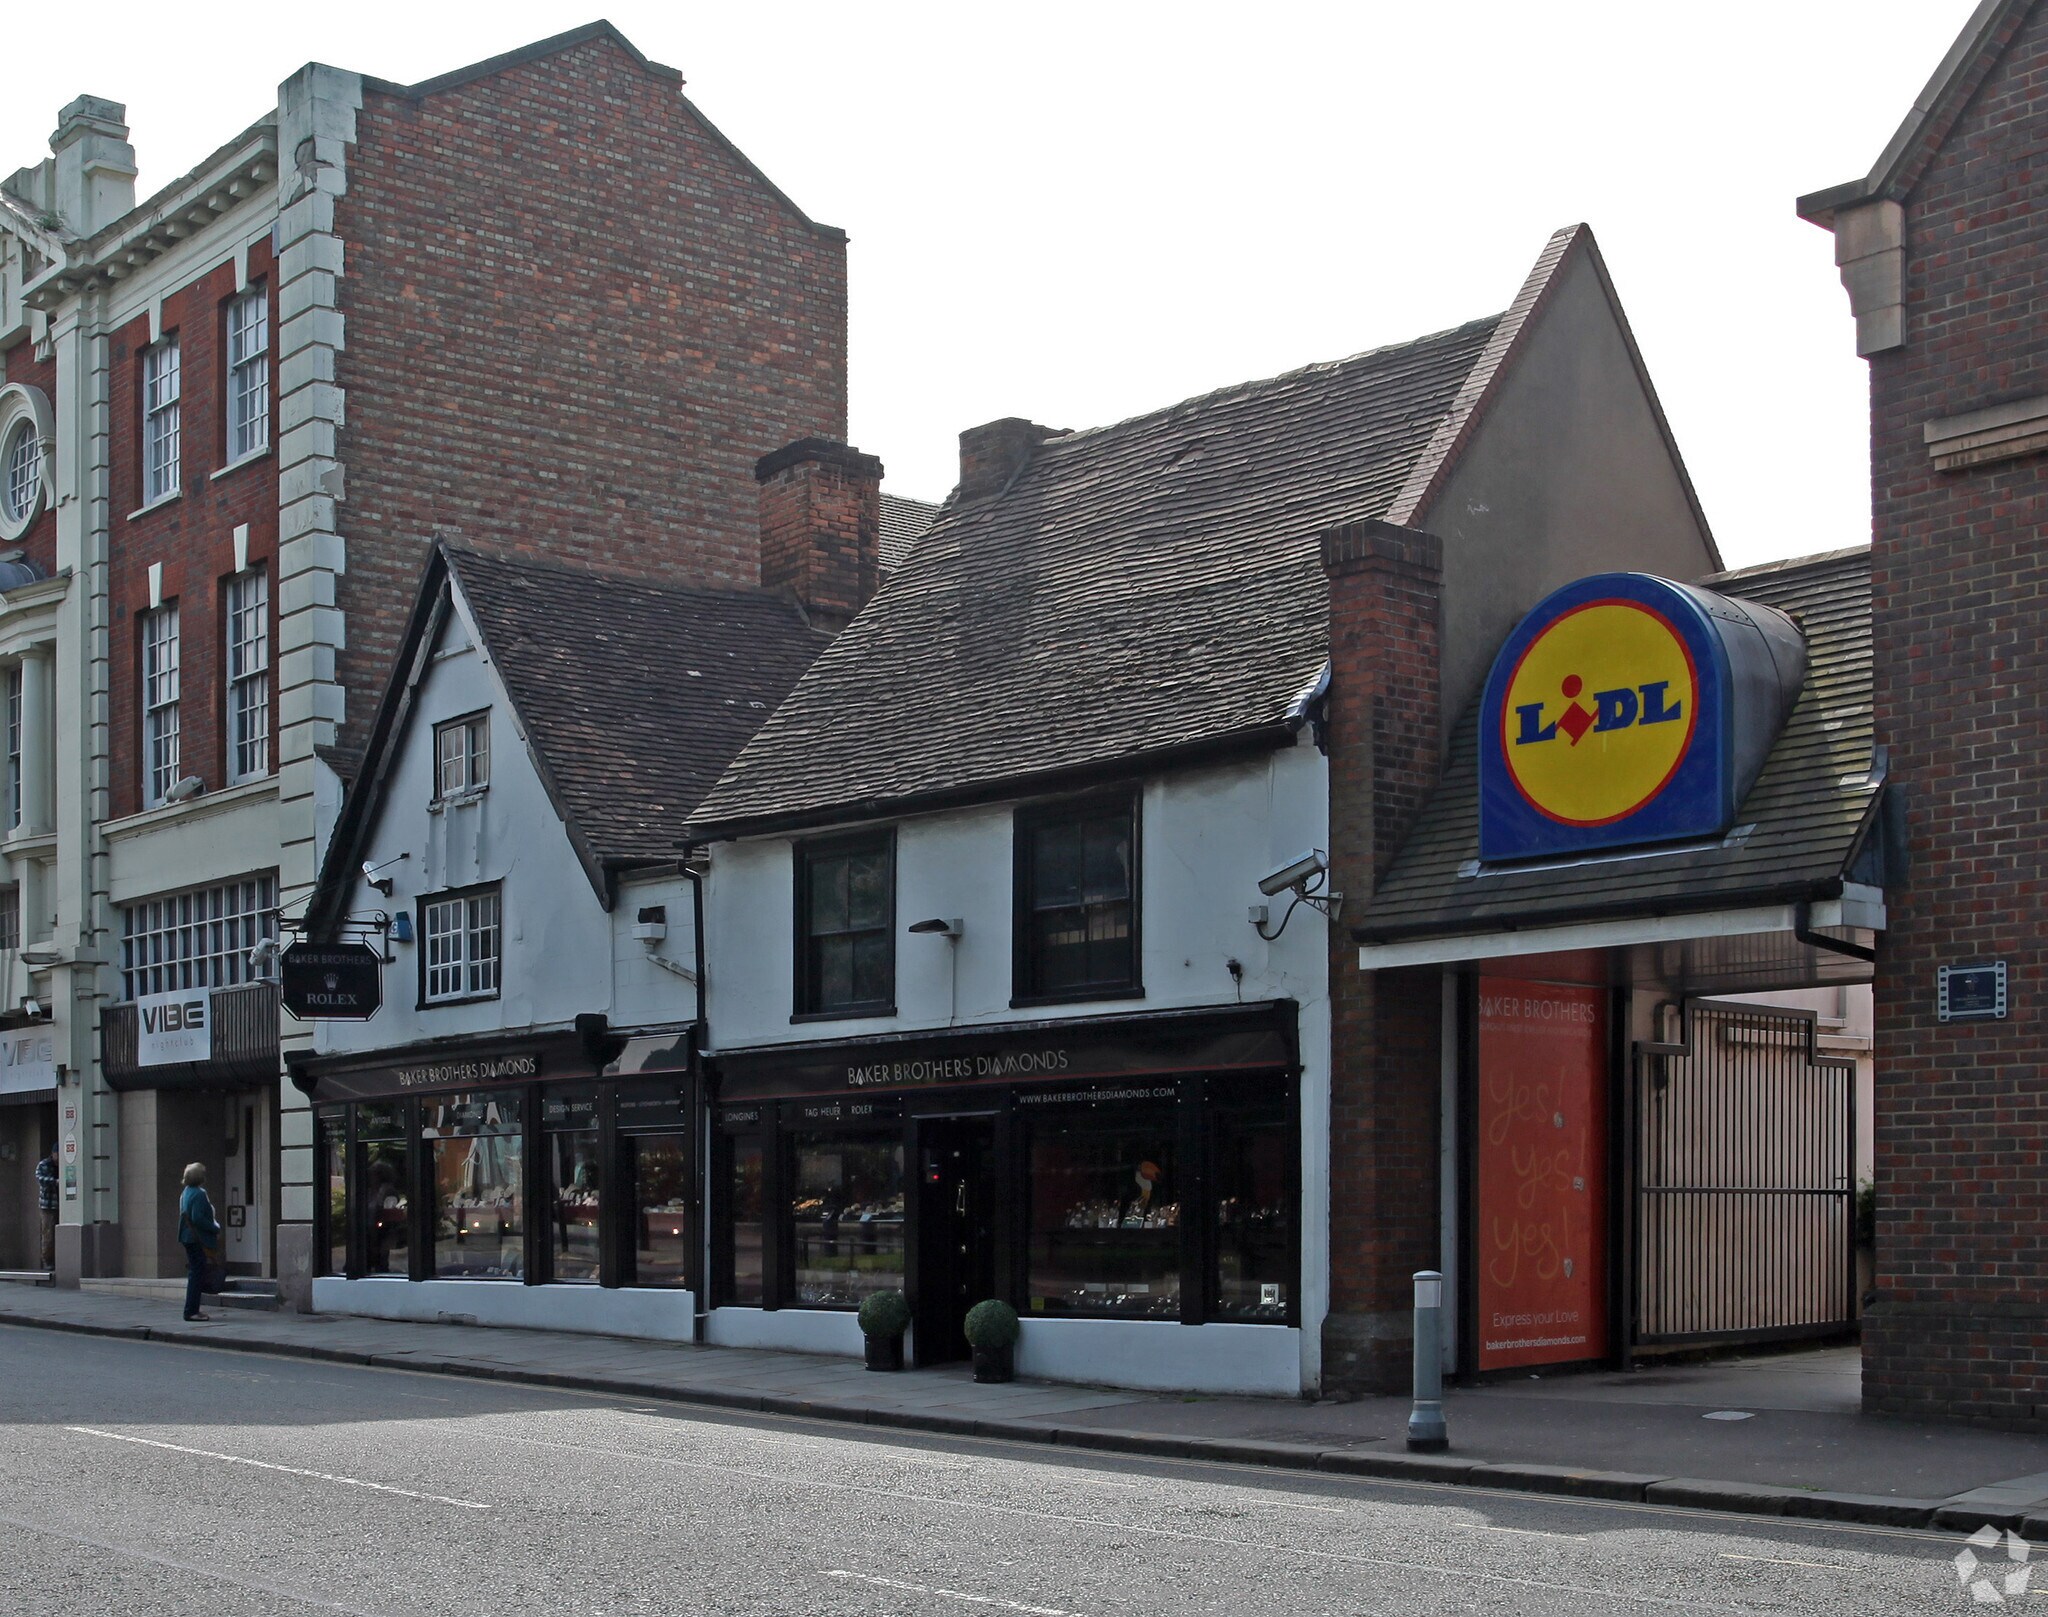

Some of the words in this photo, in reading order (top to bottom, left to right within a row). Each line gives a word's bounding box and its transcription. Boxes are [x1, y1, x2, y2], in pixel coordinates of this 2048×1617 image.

[288, 953, 319, 965] BAKER
[321, 954, 373, 966] BROTHERS
[306, 993, 358, 1005] ROLEX
[143, 1001, 204, 1035] VIBE
[1524, 999, 1596, 1023] BROTHERS
[399, 1069, 427, 1086] BAKER
[429, 1063, 479, 1083] BROTHERS
[480, 1057, 536, 1079] DIAMONDS
[848, 1066, 890, 1086] BAKER
[894, 1058, 973, 1082] BROTHERS
[976, 1050, 1069, 1076] DIAMONDS
[549, 1103, 570, 1114] DESIGN
[571, 1102, 593, 1113] SERVICE
[805, 1108, 819, 1117] TAG
[820, 1106, 842, 1117] HEUER
[851, 1104, 873, 1115] ROLEX
[725, 1111, 760, 1122] LONGINES
[1493, 1312, 1532, 1328] Express
[1533, 1313, 1554, 1328] your
[1555, 1310, 1580, 1324] Love
[1486, 1335, 1587, 1351] bakerbrothersdiamonds.com
